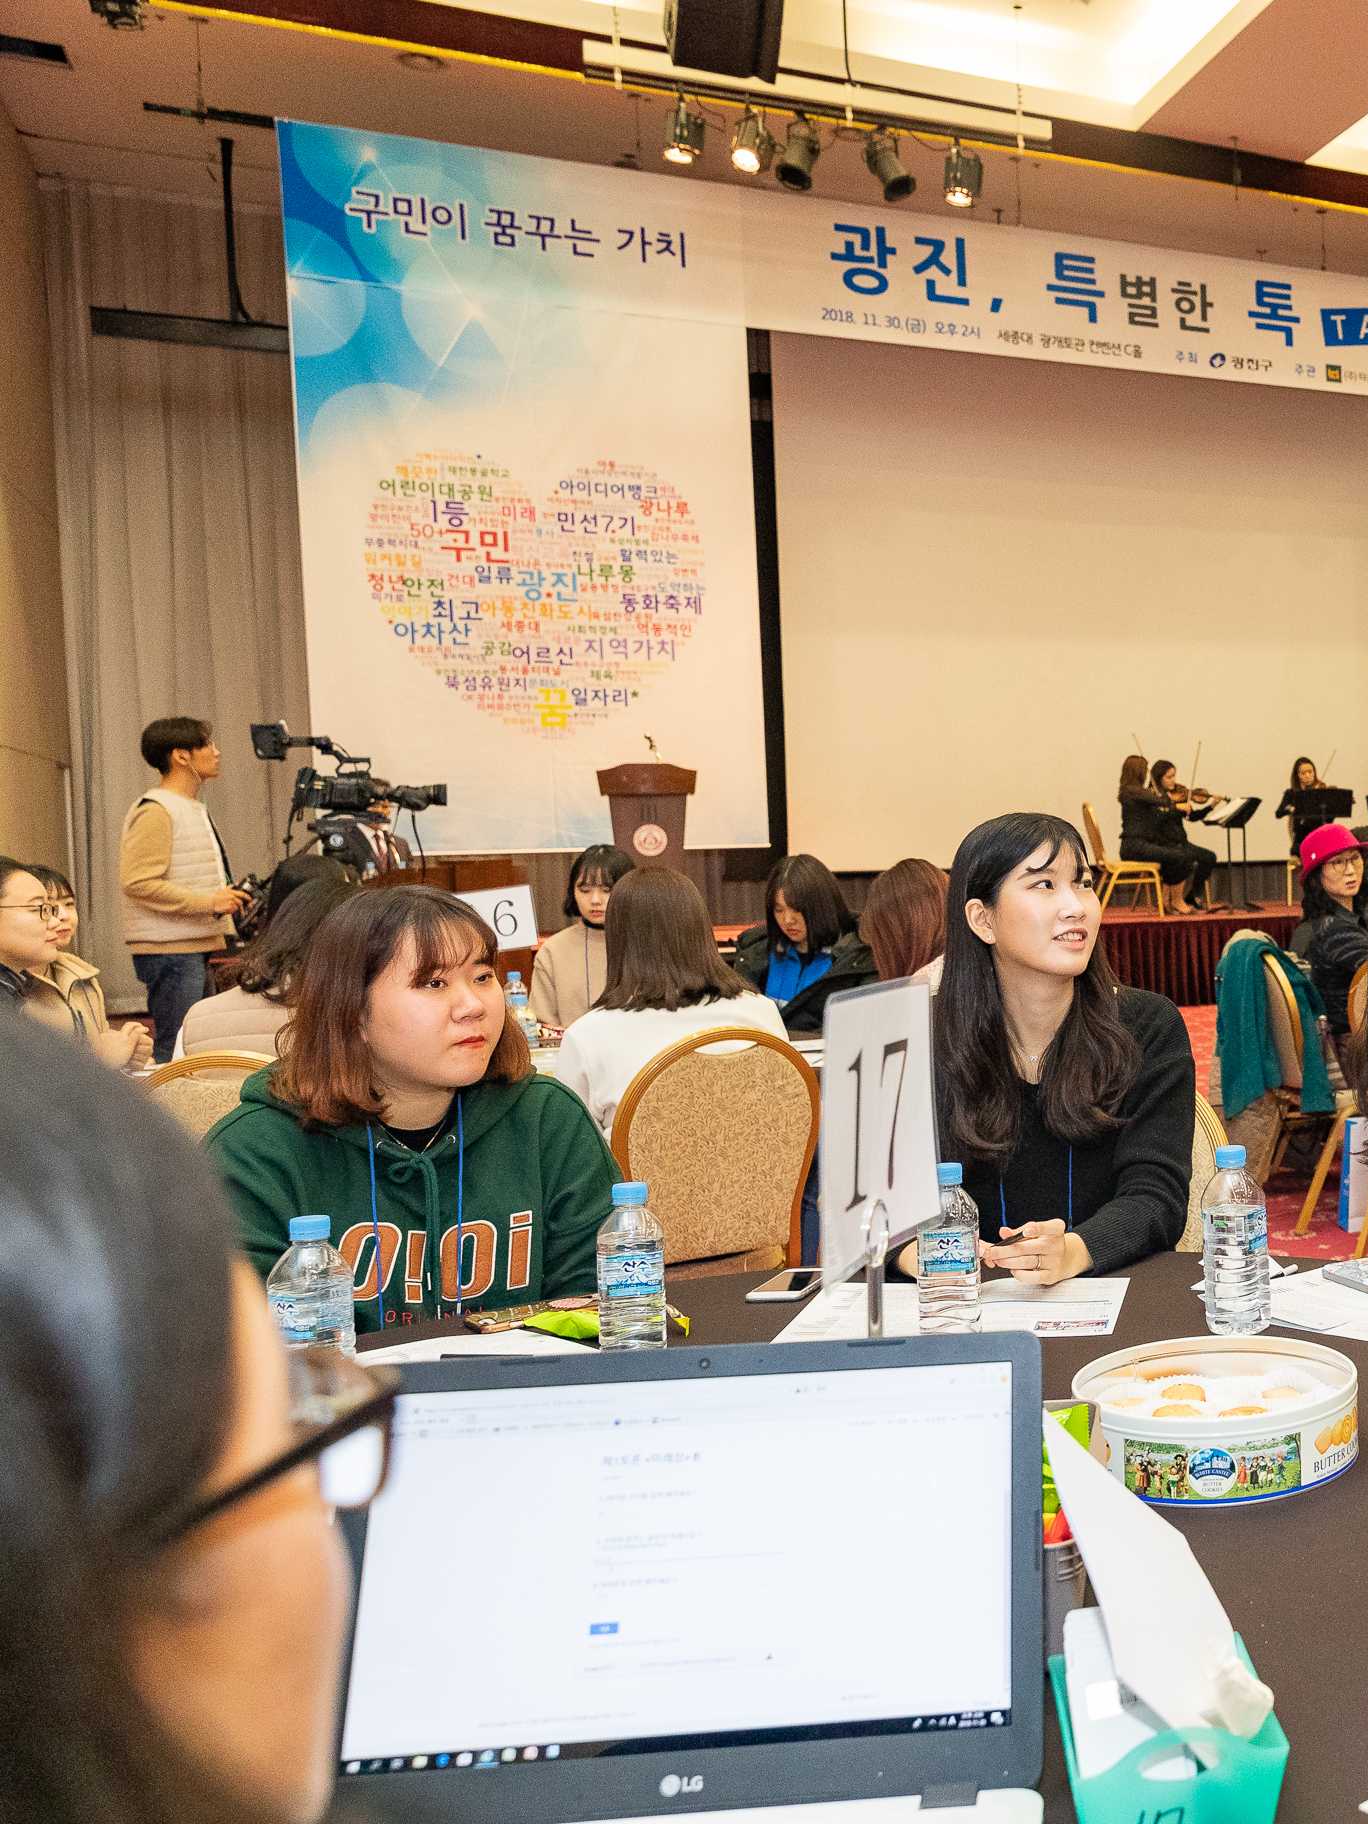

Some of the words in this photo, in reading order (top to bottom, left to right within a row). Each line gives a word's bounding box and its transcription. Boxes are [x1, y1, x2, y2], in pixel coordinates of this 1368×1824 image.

[345, 188, 470, 241] 구민이
[483, 206, 601, 259] 꿈꾸는
[616, 225, 689, 268] 가치
[830, 222, 1004, 313] 광진,
[1045, 251, 1214, 334] 특별한
[1247, 279, 1300, 347] 톡
[821, 306, 855, 324] 2018.
[934, 320, 957, 337] 오후
[960, 324, 982, 340] 2시
[997, 328, 1034, 346] 세종대
[1231, 355, 1273, 372] 광진구
[379, 479, 493, 502] 어린이대공원
[559, 480, 658, 500] 아이디어뱅크
[431, 500, 469, 527] 1등
[502, 505, 536, 523] 미래
[639, 499, 691, 518] 광나루
[557, 512, 636, 536] 민선7기
[441, 529, 509, 563] 구민
[367, 573, 405, 592] 청년
[475, 565, 513, 585] 일류
[403, 577, 445, 598] 안전
[516, 570, 579, 602] 광진
[433, 599, 483, 623] 최고
[478, 601, 593, 622] 아동친화도시
[620, 594, 702, 615] 동화축제
[394, 621, 473, 647] 아차산
[500, 620, 541, 634] 세종대
[512, 645, 574, 666] 어르신
[584, 638, 676, 662] 지역가치
[446, 674, 528, 693] 뚝섬유원지
[534, 688, 573, 728] 꿈
[571, 688, 629, 707] 일자리
[845, 1038, 909, 1212] 17
[1313, 1450, 1347, 1474] BUTTER
[1194, 1468, 1211, 1479] WHITE
[1211, 1468, 1231, 1478] CASTLE
[681, 1774, 704, 1794] LG
